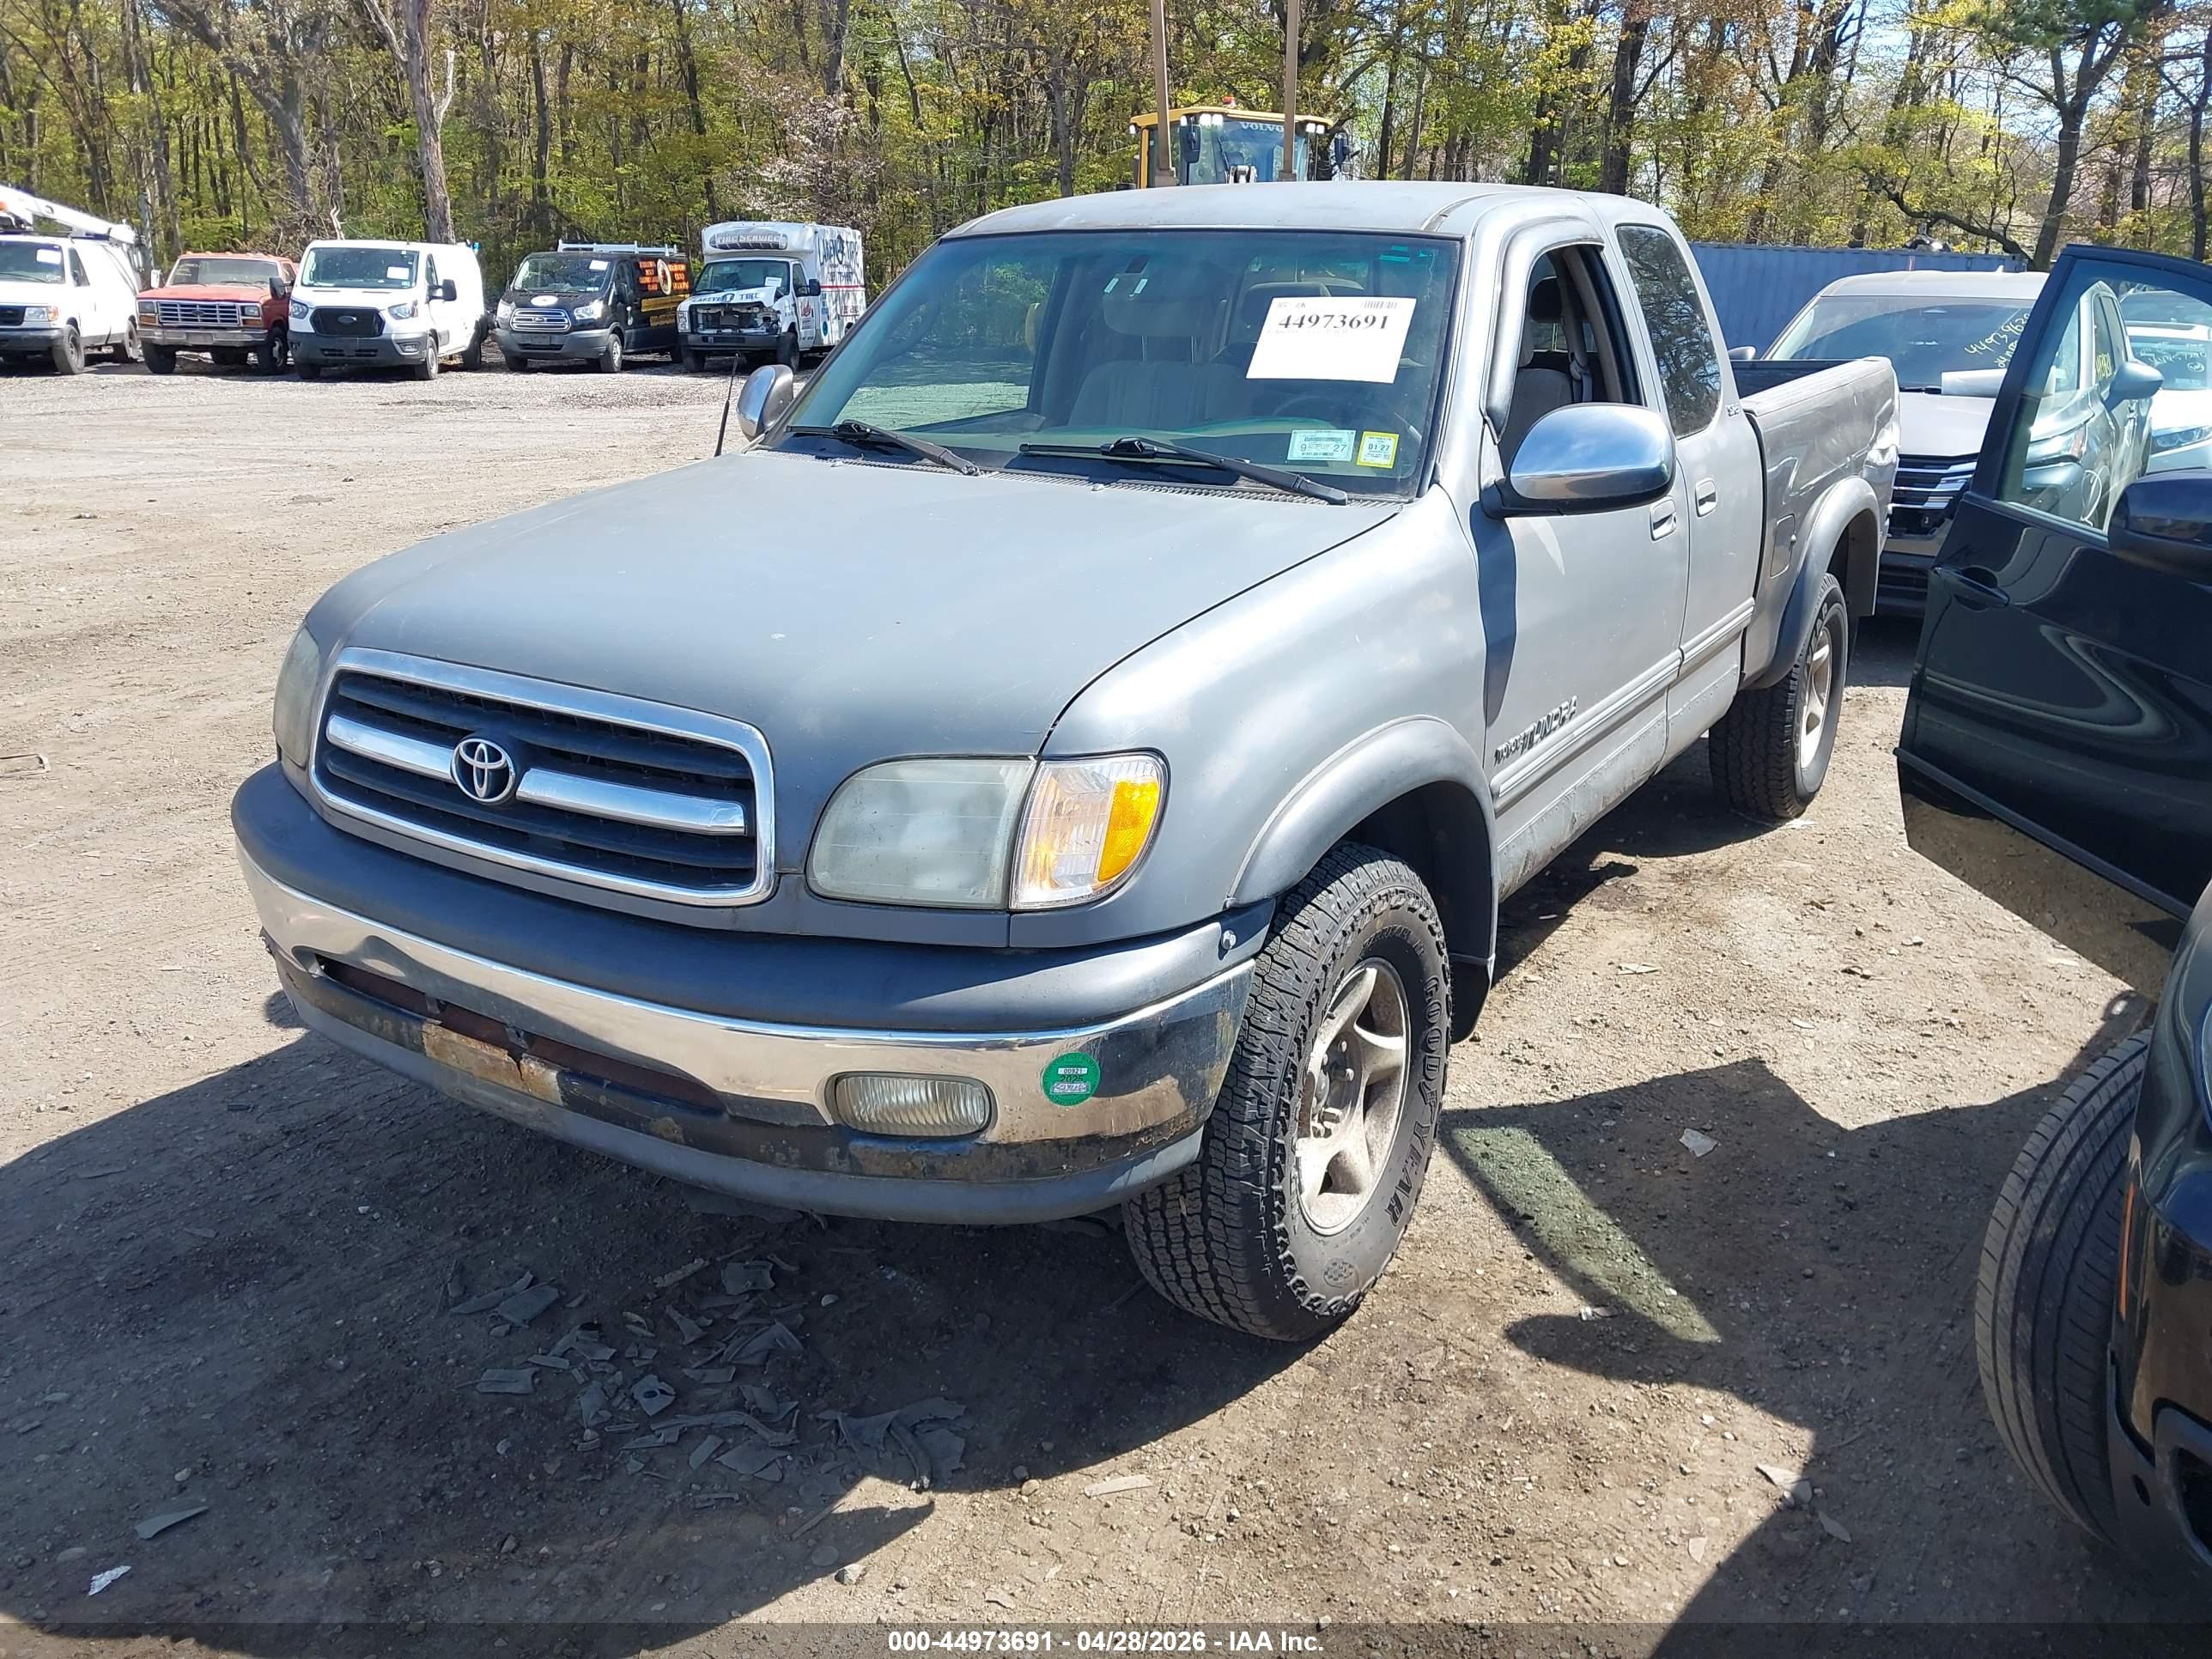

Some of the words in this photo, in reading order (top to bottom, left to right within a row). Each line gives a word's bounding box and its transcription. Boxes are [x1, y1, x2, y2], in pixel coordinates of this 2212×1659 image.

[1239, 121, 1285, 132] VOLVO
[1278, 314, 1389, 330] 44973691
[1333, 444, 1347, 453] 27
